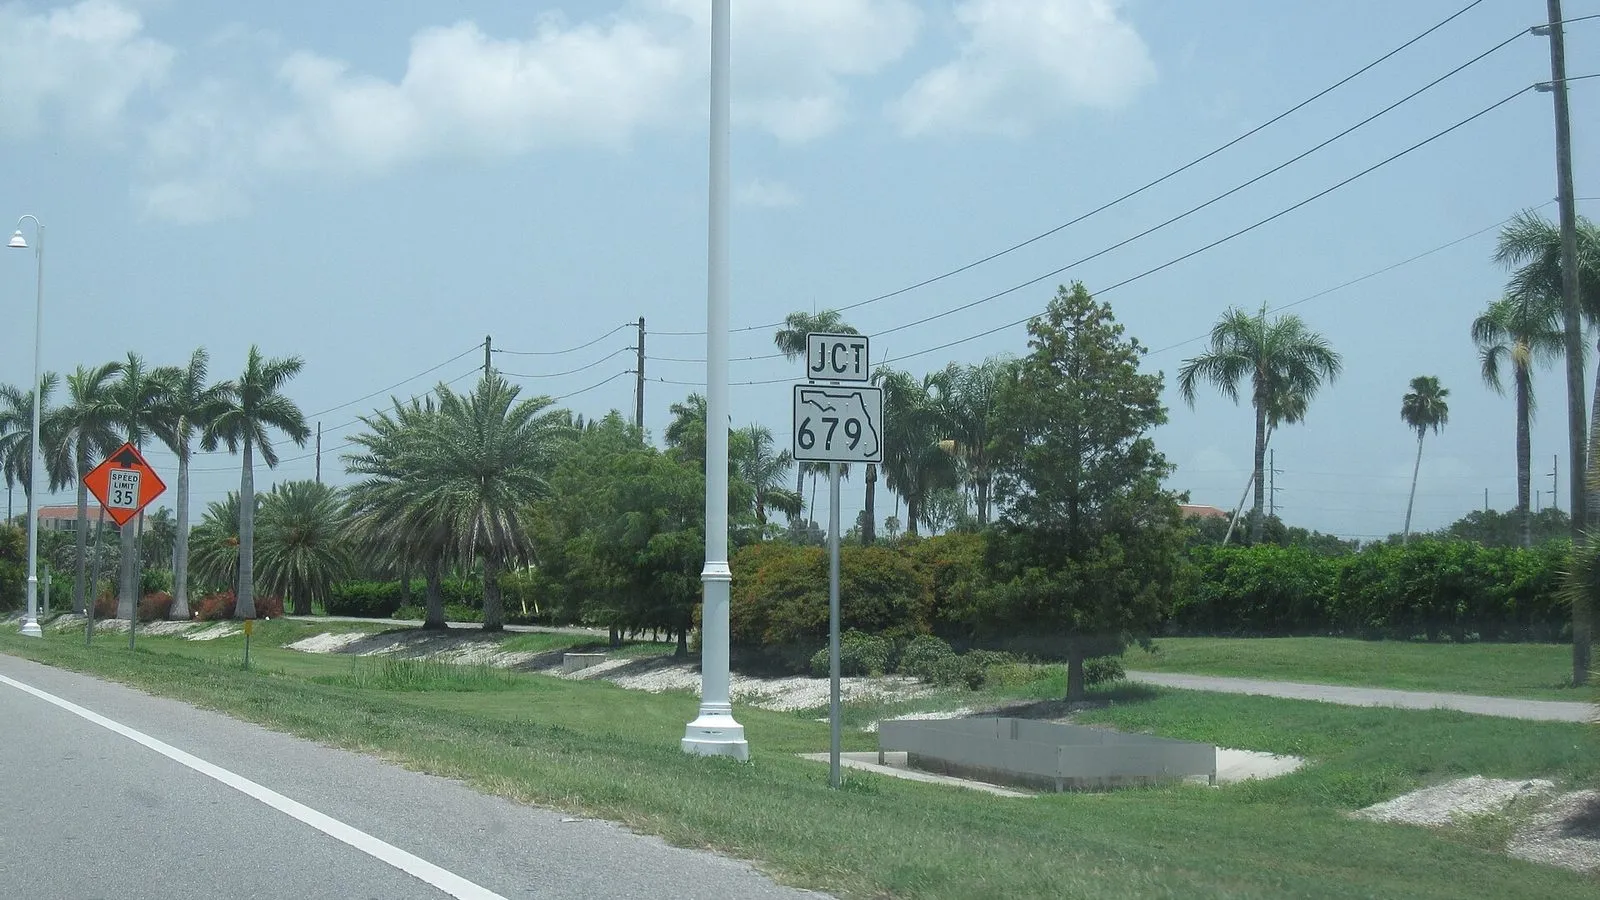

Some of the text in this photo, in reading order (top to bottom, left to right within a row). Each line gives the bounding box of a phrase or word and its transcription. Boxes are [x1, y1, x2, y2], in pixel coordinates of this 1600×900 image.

[811, 342, 864, 374] JCT
[798, 416, 862, 451] 679
[112, 473, 138, 482] SPEED
[114, 482, 135, 490] LIMIT
[113, 490, 133, 505] 35
